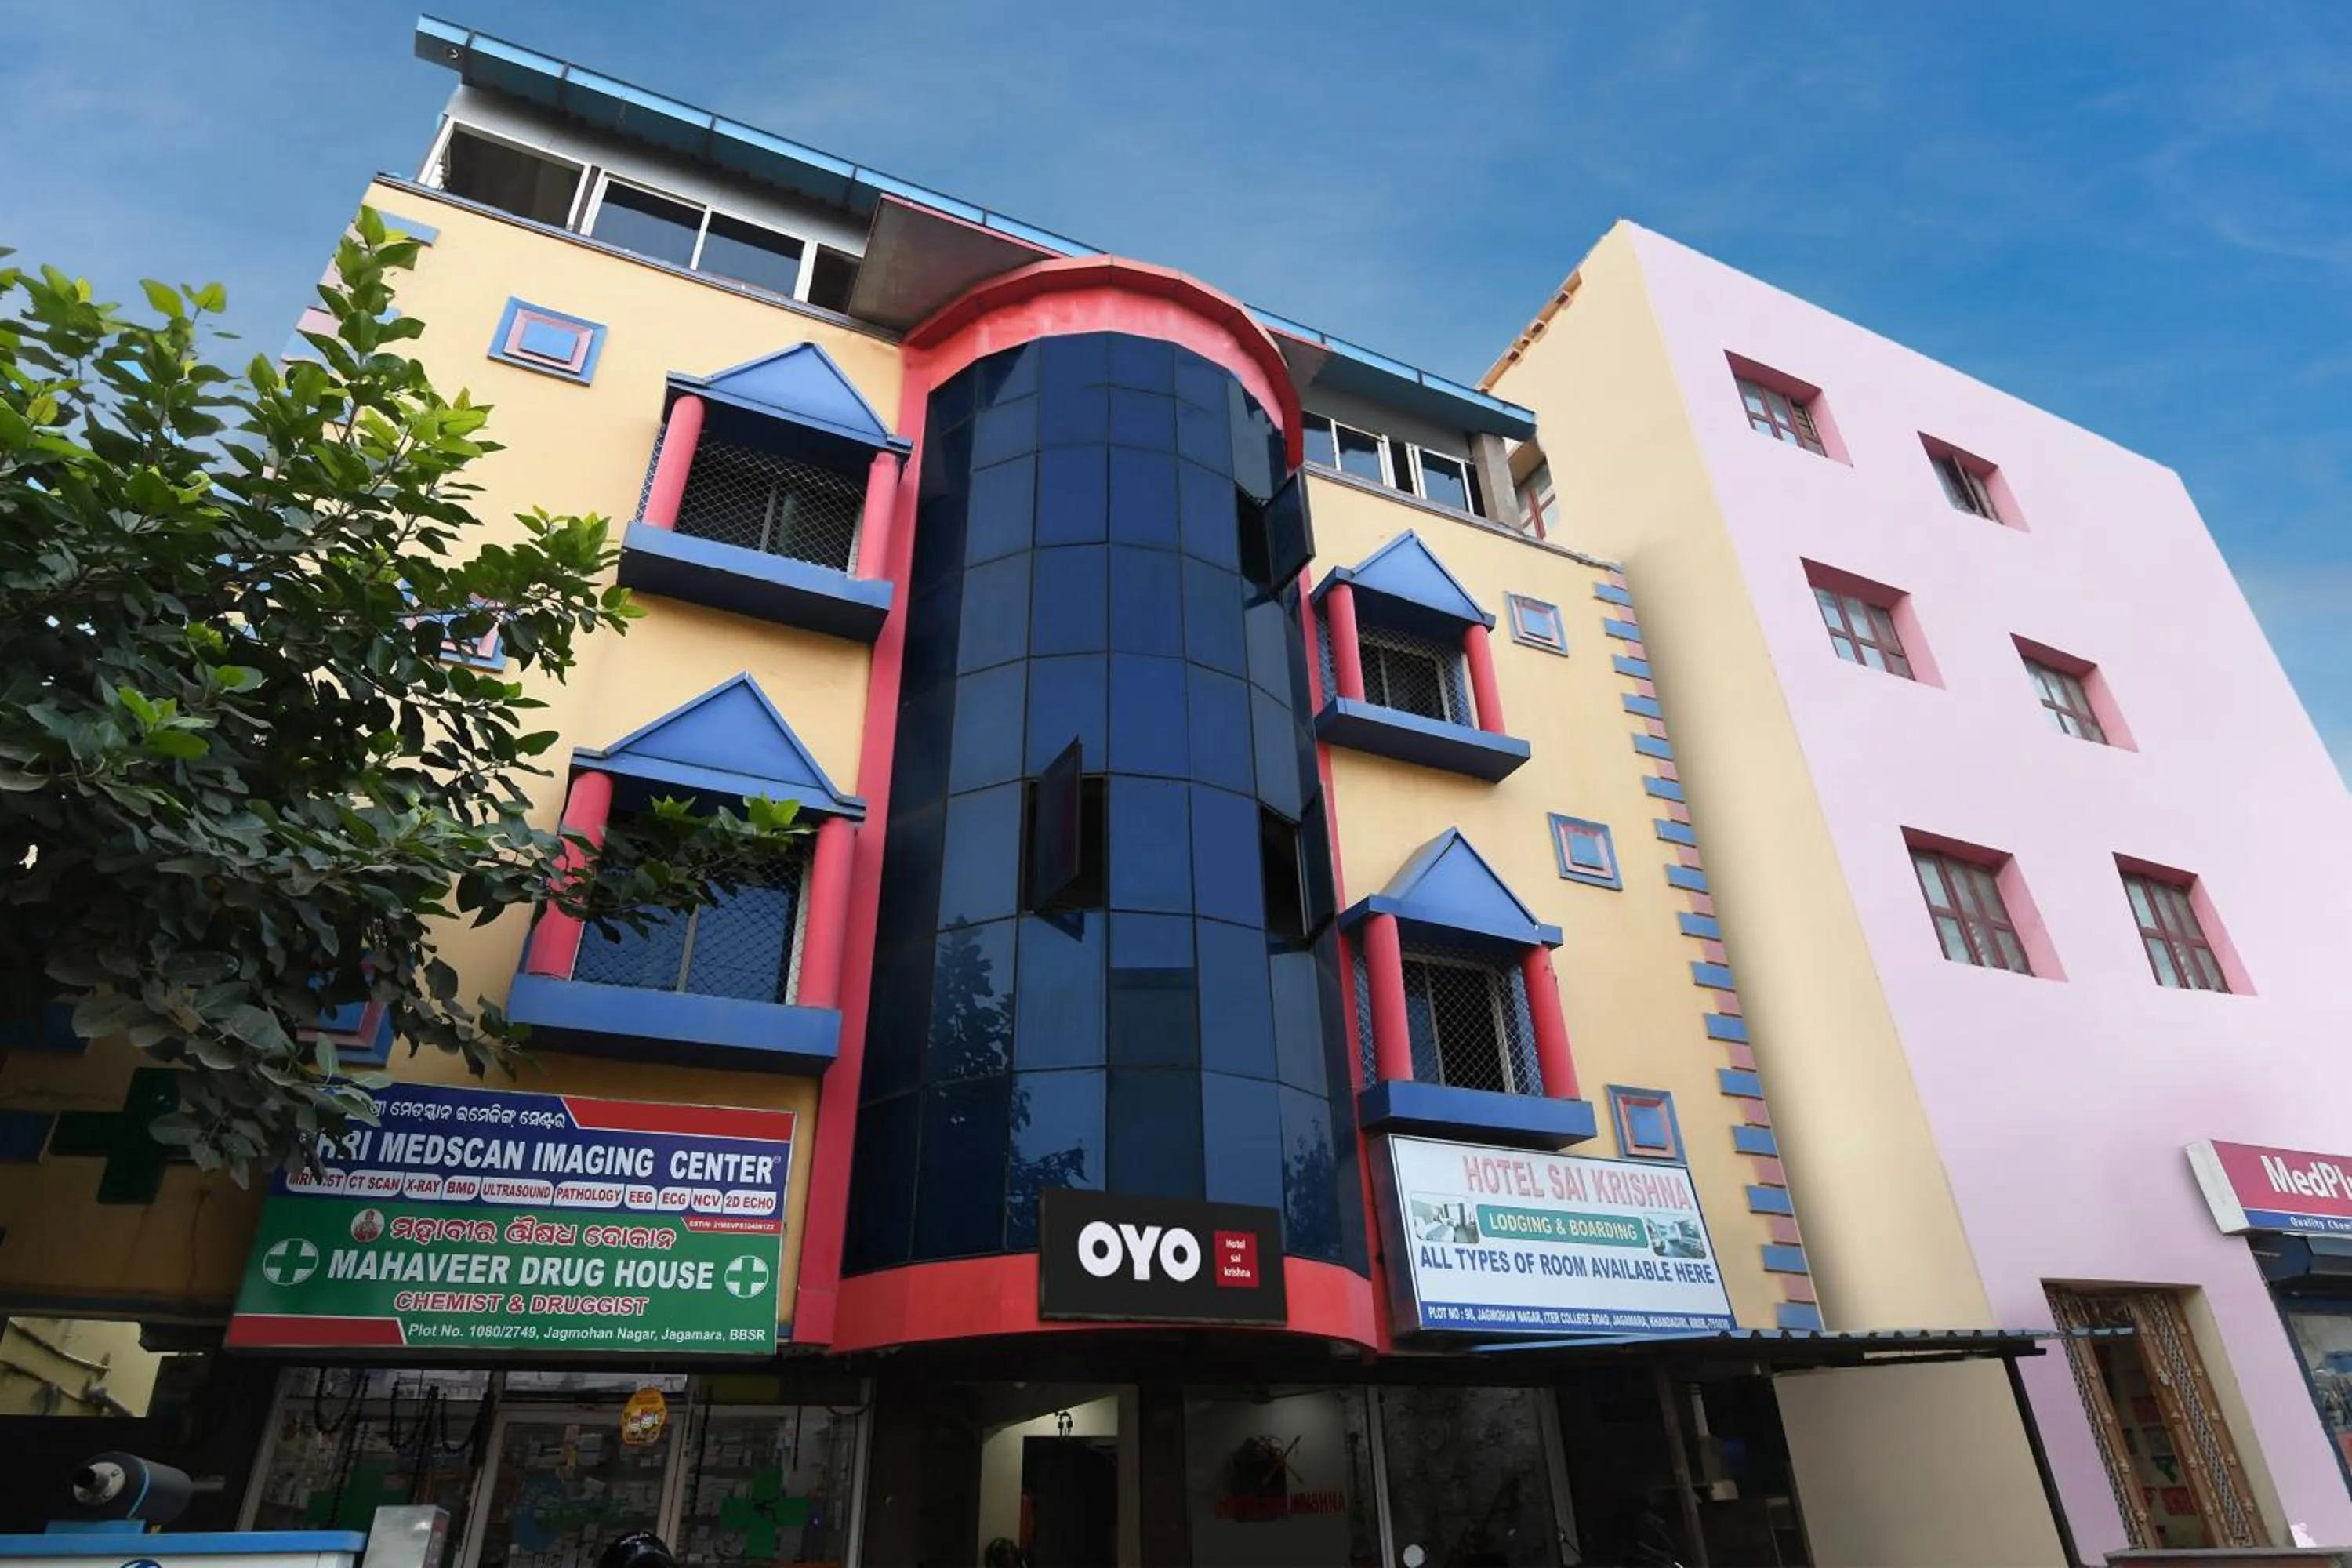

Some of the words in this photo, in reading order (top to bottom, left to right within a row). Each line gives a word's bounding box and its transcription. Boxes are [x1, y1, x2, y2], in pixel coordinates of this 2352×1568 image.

[299, 1130, 373, 1161] HRI
[378, 1131, 526, 1171] MEDSCAN
[532, 1142, 654, 1178] IMAGING
[670, 1150, 773, 1185] CENTER
[318, 1174, 344, 1188] .5T
[349, 1176, 367, 1189] CT
[368, 1178, 401, 1191] SCAN
[405, 1178, 441, 1193] X-RAY
[447, 1182, 476, 1196] BMD
[1463, 1155, 1545, 1198] HOTEL
[1547, 1163, 1588, 1203] SAI
[1592, 1168, 1693, 1210] KRISHNA
[482, 1183, 552, 1200] ULTRASOUND
[556, 1185, 622, 1203] PATHOLOGY
[628, 1190, 653, 1204] EEG
[662, 1191, 687, 1206] ECG
[693, 1192, 721, 1207] NCV
[725, 1193, 740, 1207] 2D
[742, 1195, 775, 1210] ECHO
[390, 1216, 498, 1245] ମହାବୀର
[583, 1225, 676, 1250] ଦୋକାନ
[1489, 1213, 1552, 1236] LODGING
[1555, 1218, 1567, 1236] &
[1569, 1219, 1637, 1240] BOARDING
[1078, 1221, 1201, 1282] OYO
[1229, 1254, 1241, 1263] sai
[327, 1249, 510, 1284] MAHAVEER
[519, 1256, 605, 1287] DRUG
[614, 1259, 714, 1290] HOUSE
[1421, 1245, 1452, 1271] ALL
[1455, 1247, 1510, 1274] TYPES
[1515, 1251, 1534, 1276] OF
[1541, 1254, 1588, 1278] ROOM
[1592, 1258, 1673, 1282] AVAILABLE
[1675, 1263, 1715, 1283] HERE
[394, 1291, 503, 1312] CHEMIST
[507, 1294, 524, 1313] &
[531, 1295, 649, 1316] DRUGGIST
[408, 1324, 436, 1337] Plot
[440, 1325, 464, 1338] No.
[470, 1325, 539, 1339] 1080/2749,
[543, 1326, 614, 1341] Jagmohan
[617, 1327, 658, 1341] Nagar,
[661, 1328, 726, 1342] Jagamara,
[729, 1329, 765, 1341] BBSR
